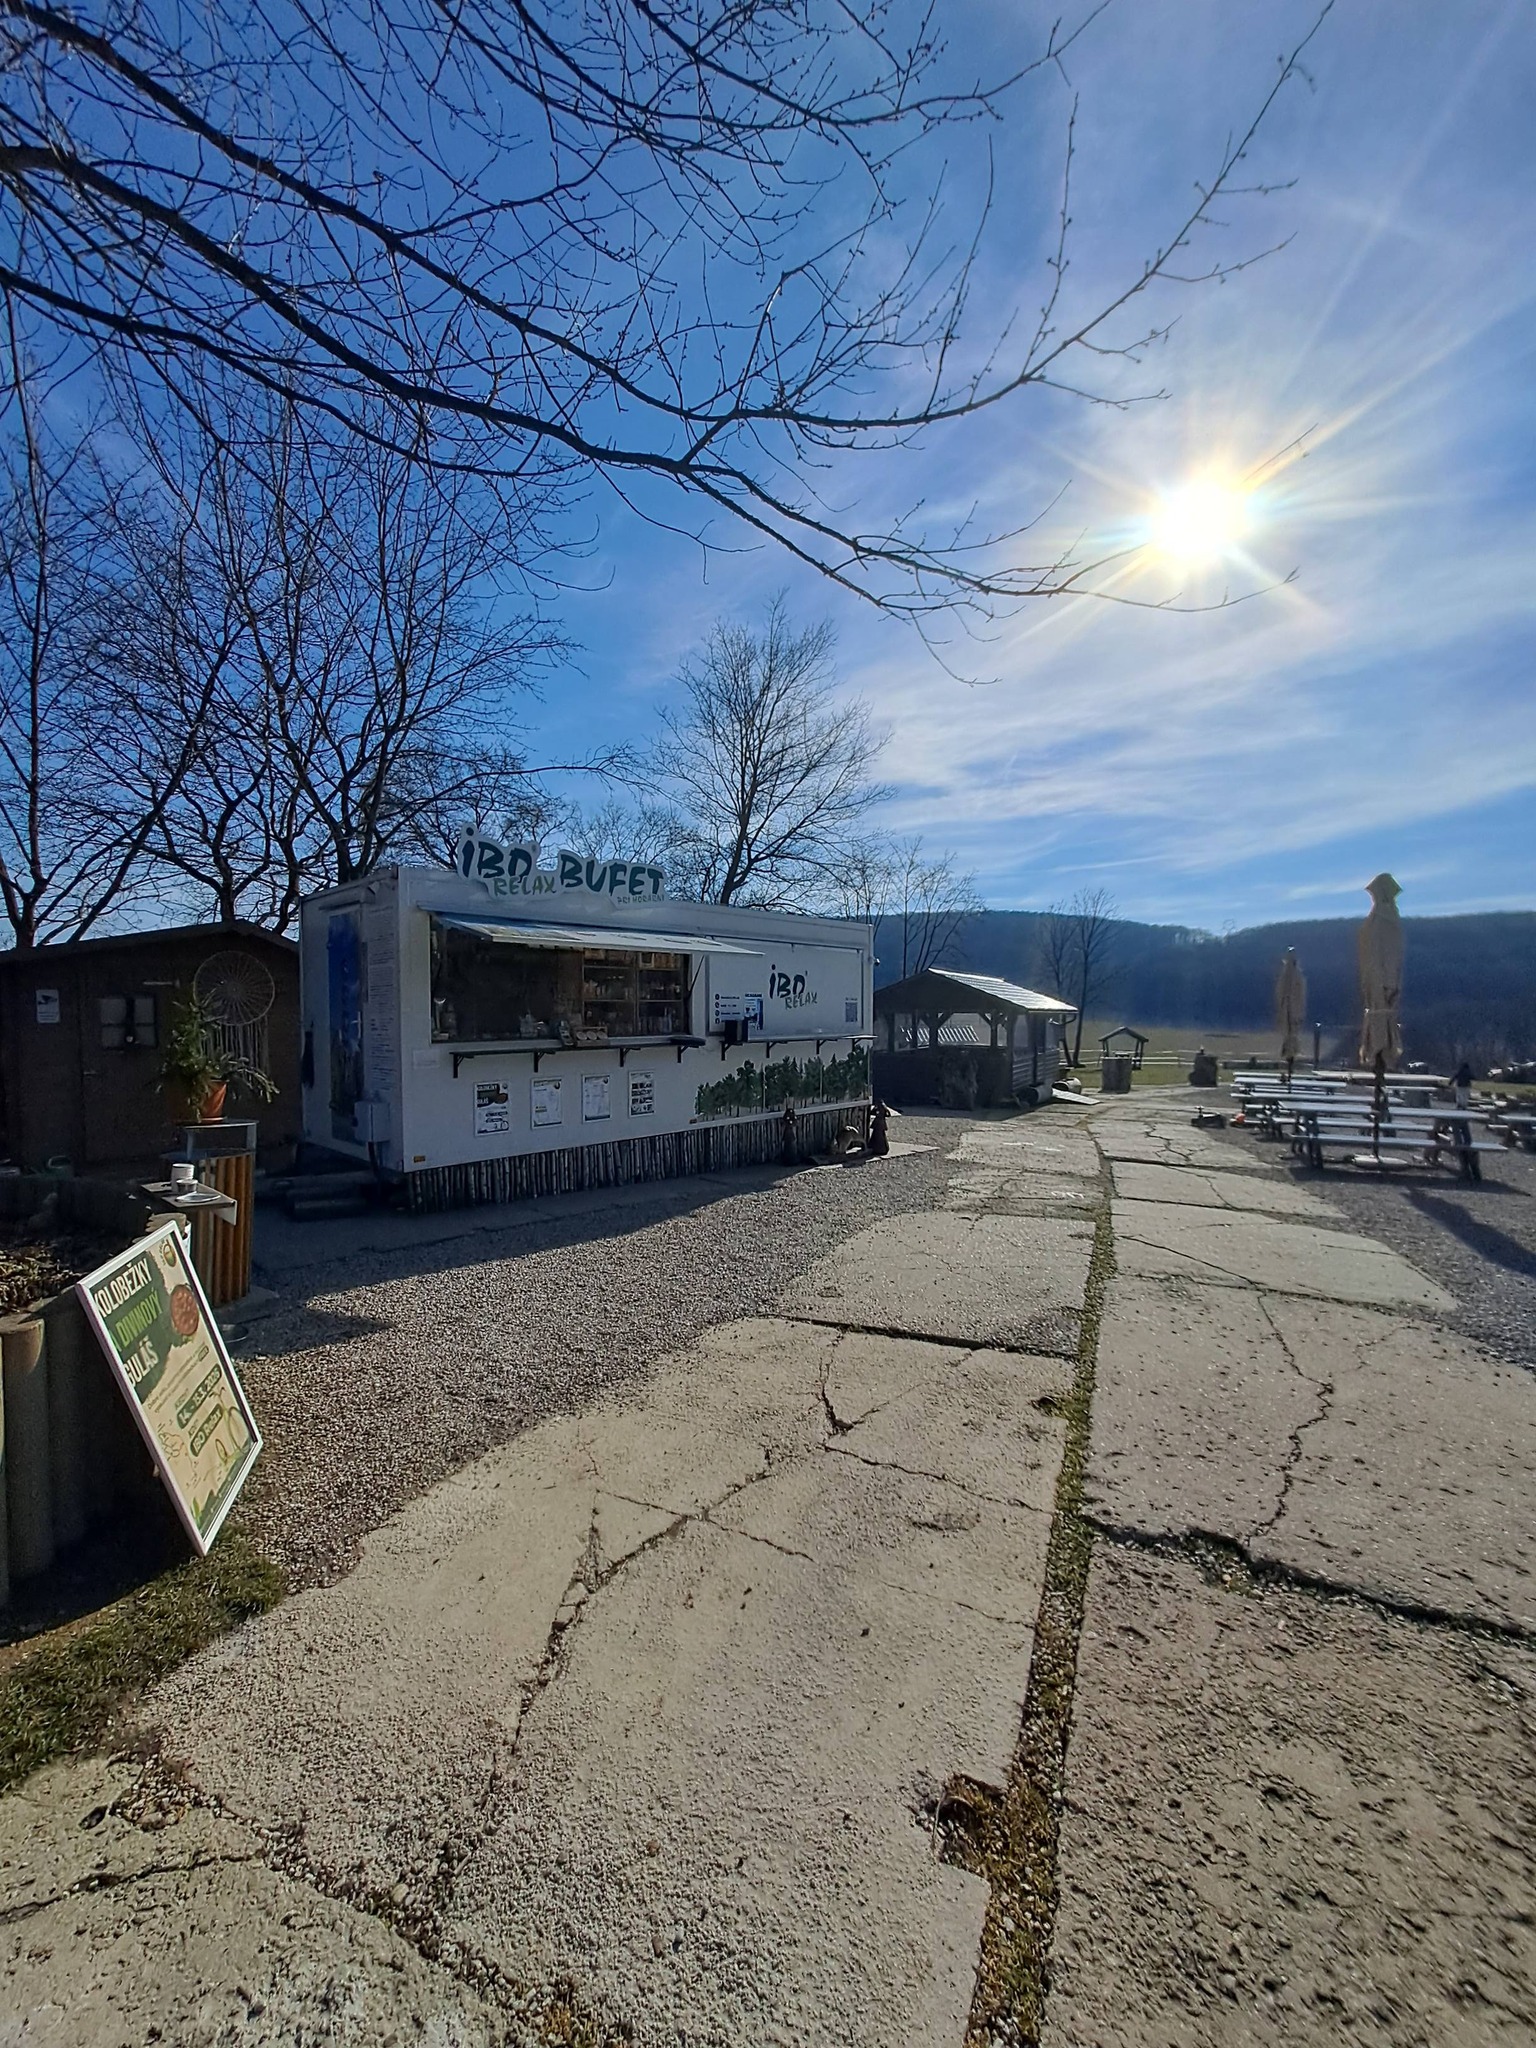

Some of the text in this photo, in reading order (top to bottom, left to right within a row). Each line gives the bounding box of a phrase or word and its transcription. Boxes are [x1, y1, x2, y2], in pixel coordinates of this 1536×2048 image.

[493, 875, 557, 897] RELAX
[560, 854, 664, 896] BUFET
[785, 992, 818, 1010] RELAX
[115, 1288, 163, 1346] DIVINOVÝ
[123, 1335, 159, 1387] GULÁŠ
